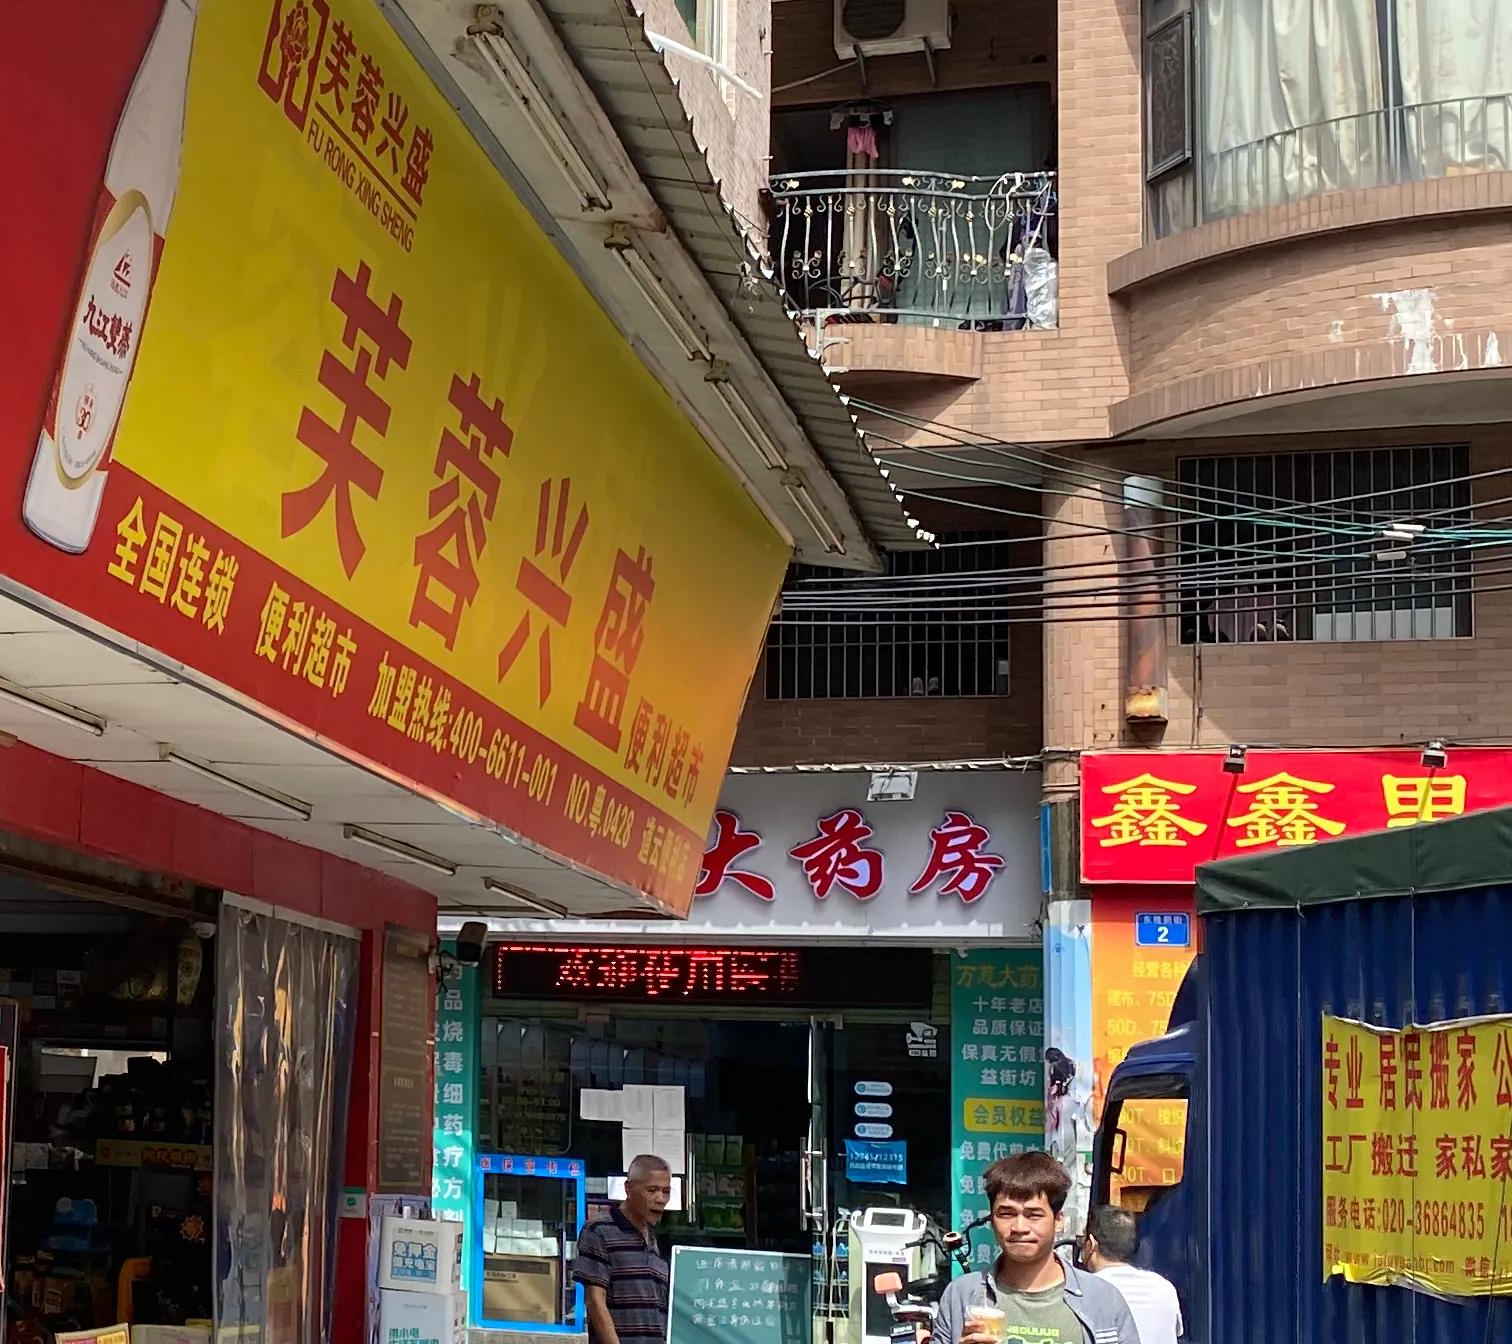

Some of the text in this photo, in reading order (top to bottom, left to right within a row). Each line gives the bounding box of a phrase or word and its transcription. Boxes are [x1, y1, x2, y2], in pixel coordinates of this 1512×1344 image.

[320, 19, 434, 207] 芙蓉兴盛
[306, 117, 416, 254] FU RONG XING SHENG
[281, 258, 656, 755] 芙蓉兴盛
[106, 495, 239, 637] 全国连锁
[254, 580, 358, 699] 便利超市
[623, 695, 705, 809] 便利超市
[696, 807, 1007, 906] 大药房
[1157, 926, 1169, 943] 2
[972, 996, 1043, 1014] 十年老店
[972, 1019, 1044, 1037] 品质保证
[980, 1068, 1037, 1087] 益街坊
[1325, 1033, 1365, 1111] 专业
[1379, 1031, 1477, 1112] 居民搬家
[1324, 1131, 1418, 1179] 工厂搬迁
